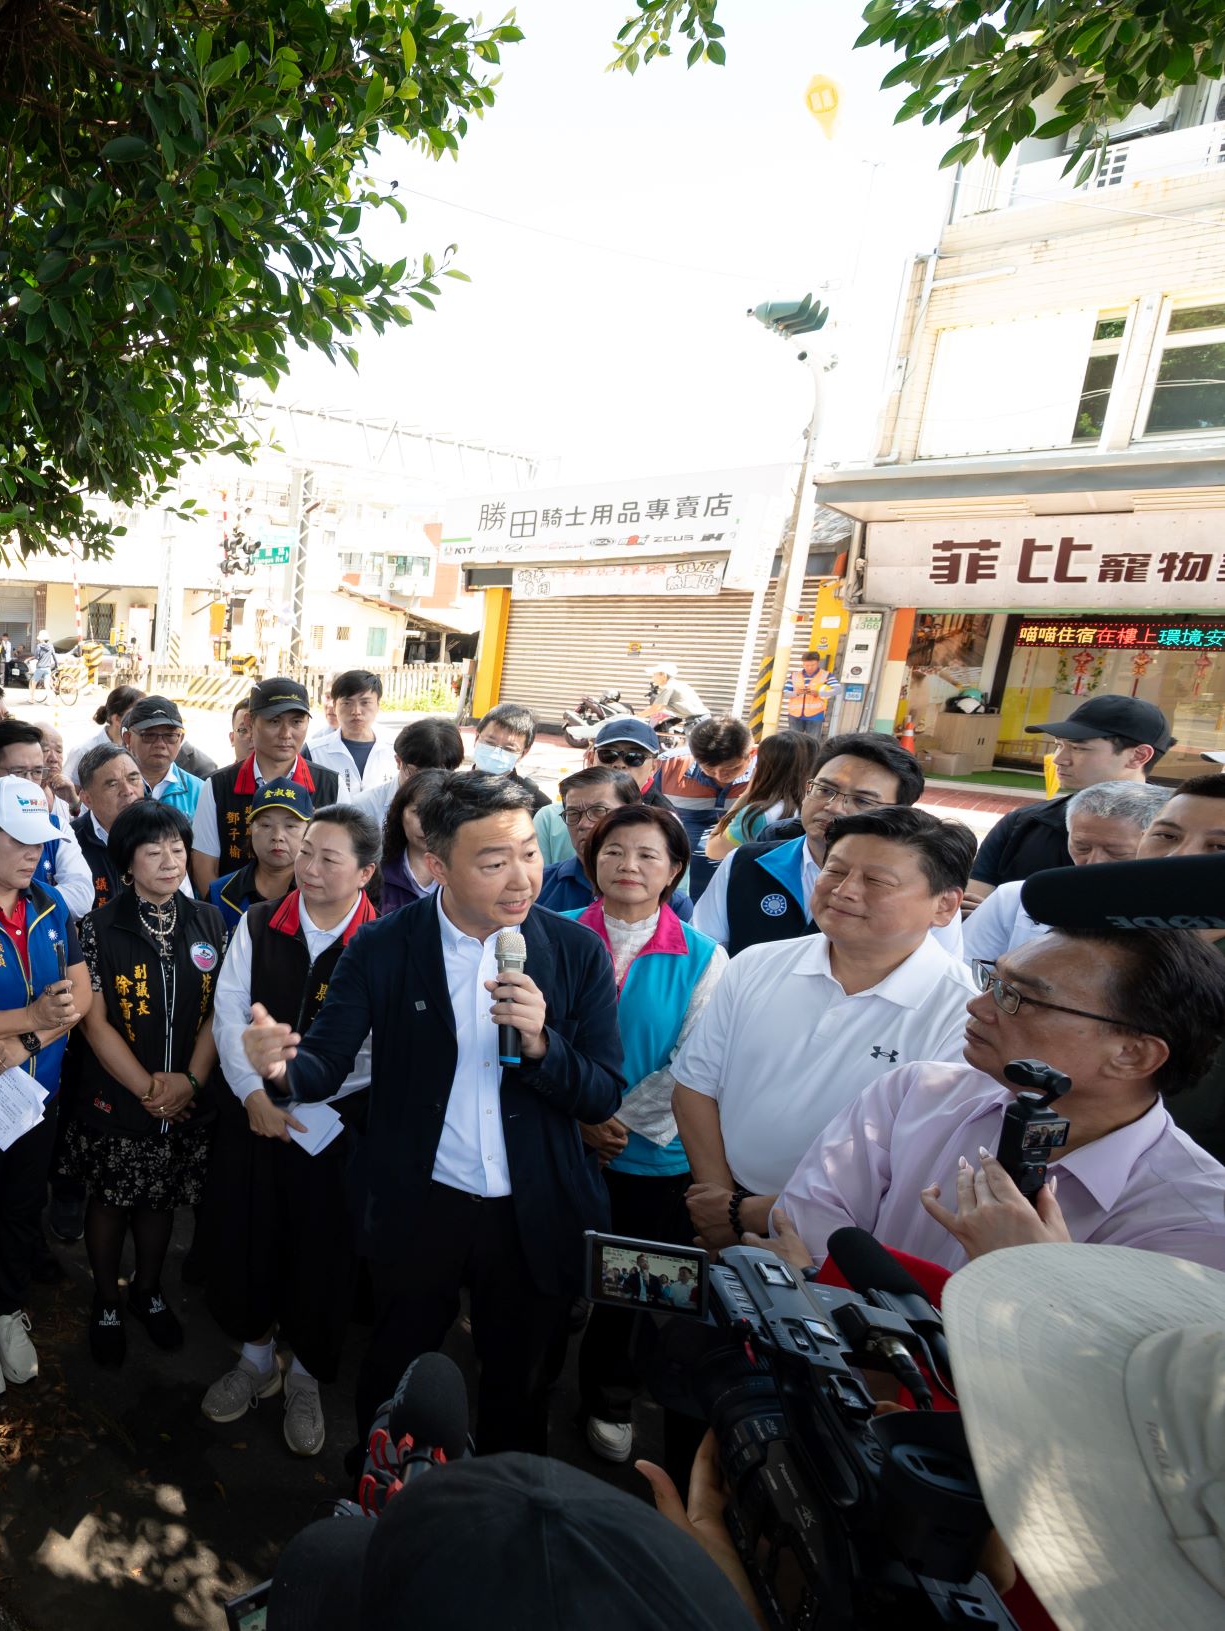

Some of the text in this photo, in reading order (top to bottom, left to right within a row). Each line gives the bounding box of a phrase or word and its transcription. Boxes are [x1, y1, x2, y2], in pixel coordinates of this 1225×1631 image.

[477, 492, 733, 538] 勝田騎士用品專賣店
[653, 534, 694, 543] ZEUS
[929, 537, 1225, 584] 菲比寵物
[134, 963, 150, 1016] 副議長
[778, 1463, 799, 1499] Panasonic
